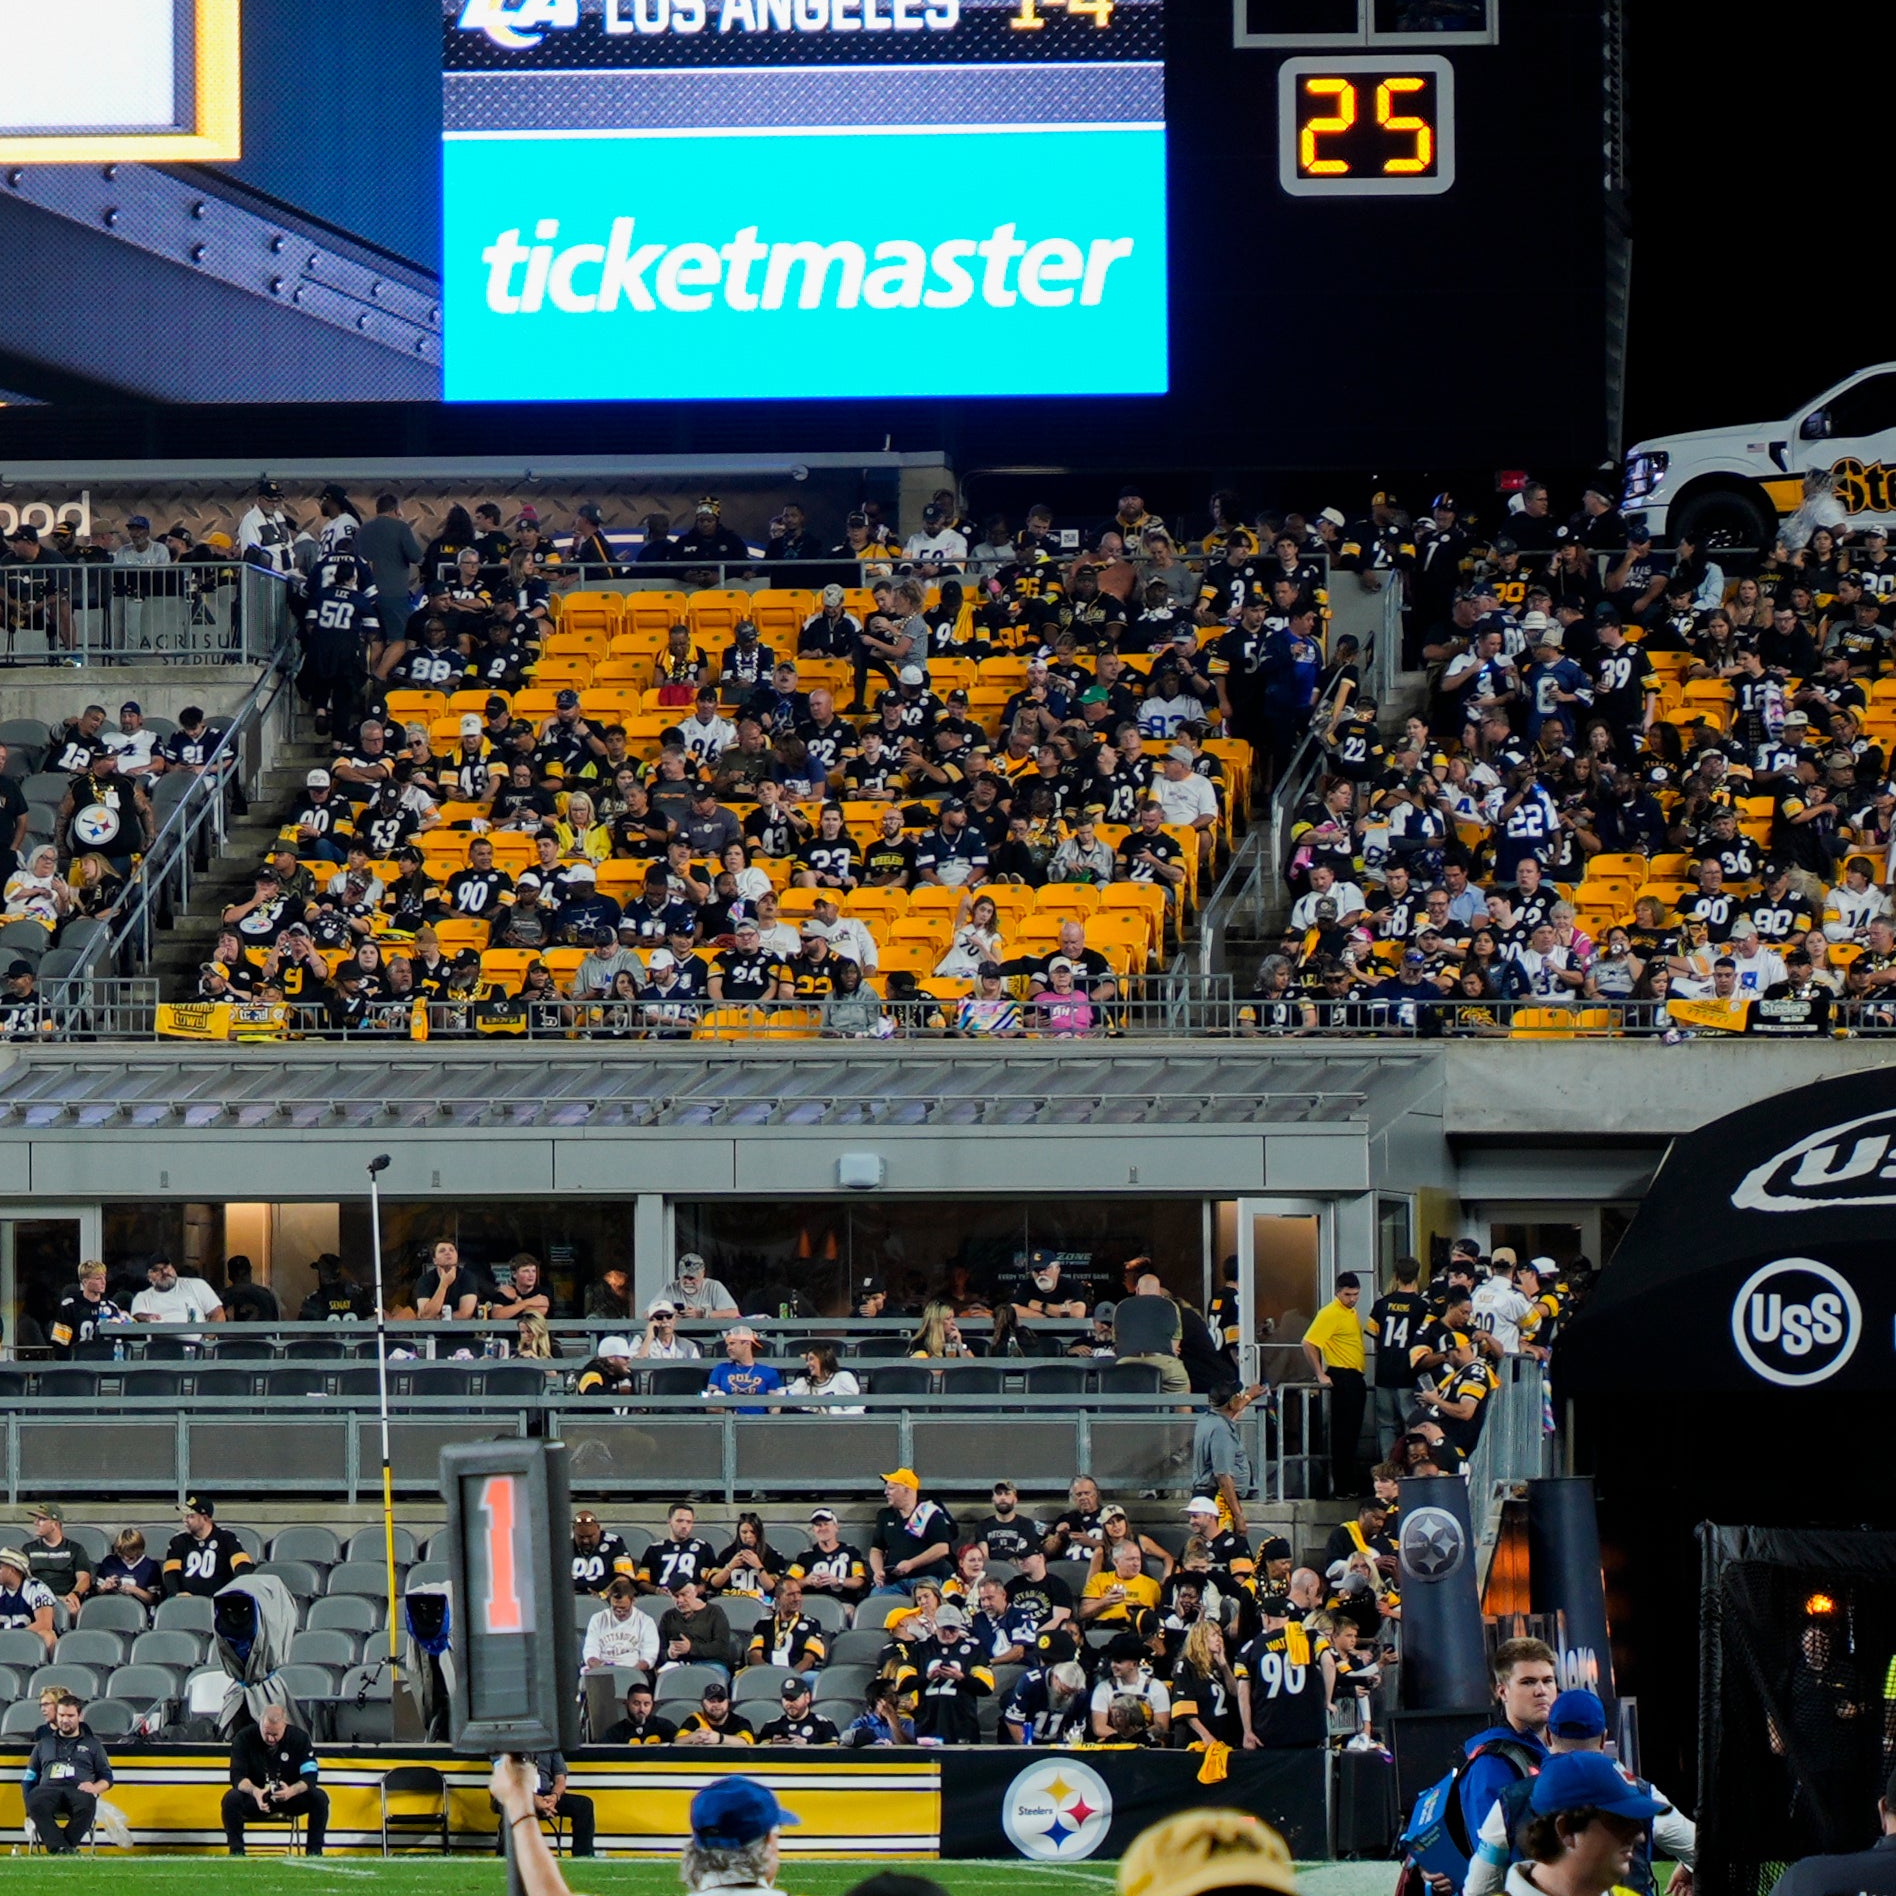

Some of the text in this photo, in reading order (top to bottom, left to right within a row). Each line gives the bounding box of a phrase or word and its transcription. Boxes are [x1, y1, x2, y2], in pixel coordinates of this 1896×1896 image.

[1298, 77, 1433, 174] 25
[480, 215, 1133, 313] ticketmaster
[319, 601, 355, 629] 50
[1344, 736, 1366, 762] 22
[1508, 805, 1544, 838] 22
[458, 882, 488, 910] 90
[1383, 1315, 1409, 1349] 14
[1752, 1293, 1842, 1355] USS
[728, 1374, 762, 1386] POLO
[479, 1476, 522, 1633] 1
[1211, 1683, 1228, 1716] 2
[1018, 1806, 1054, 1816] Steelers
